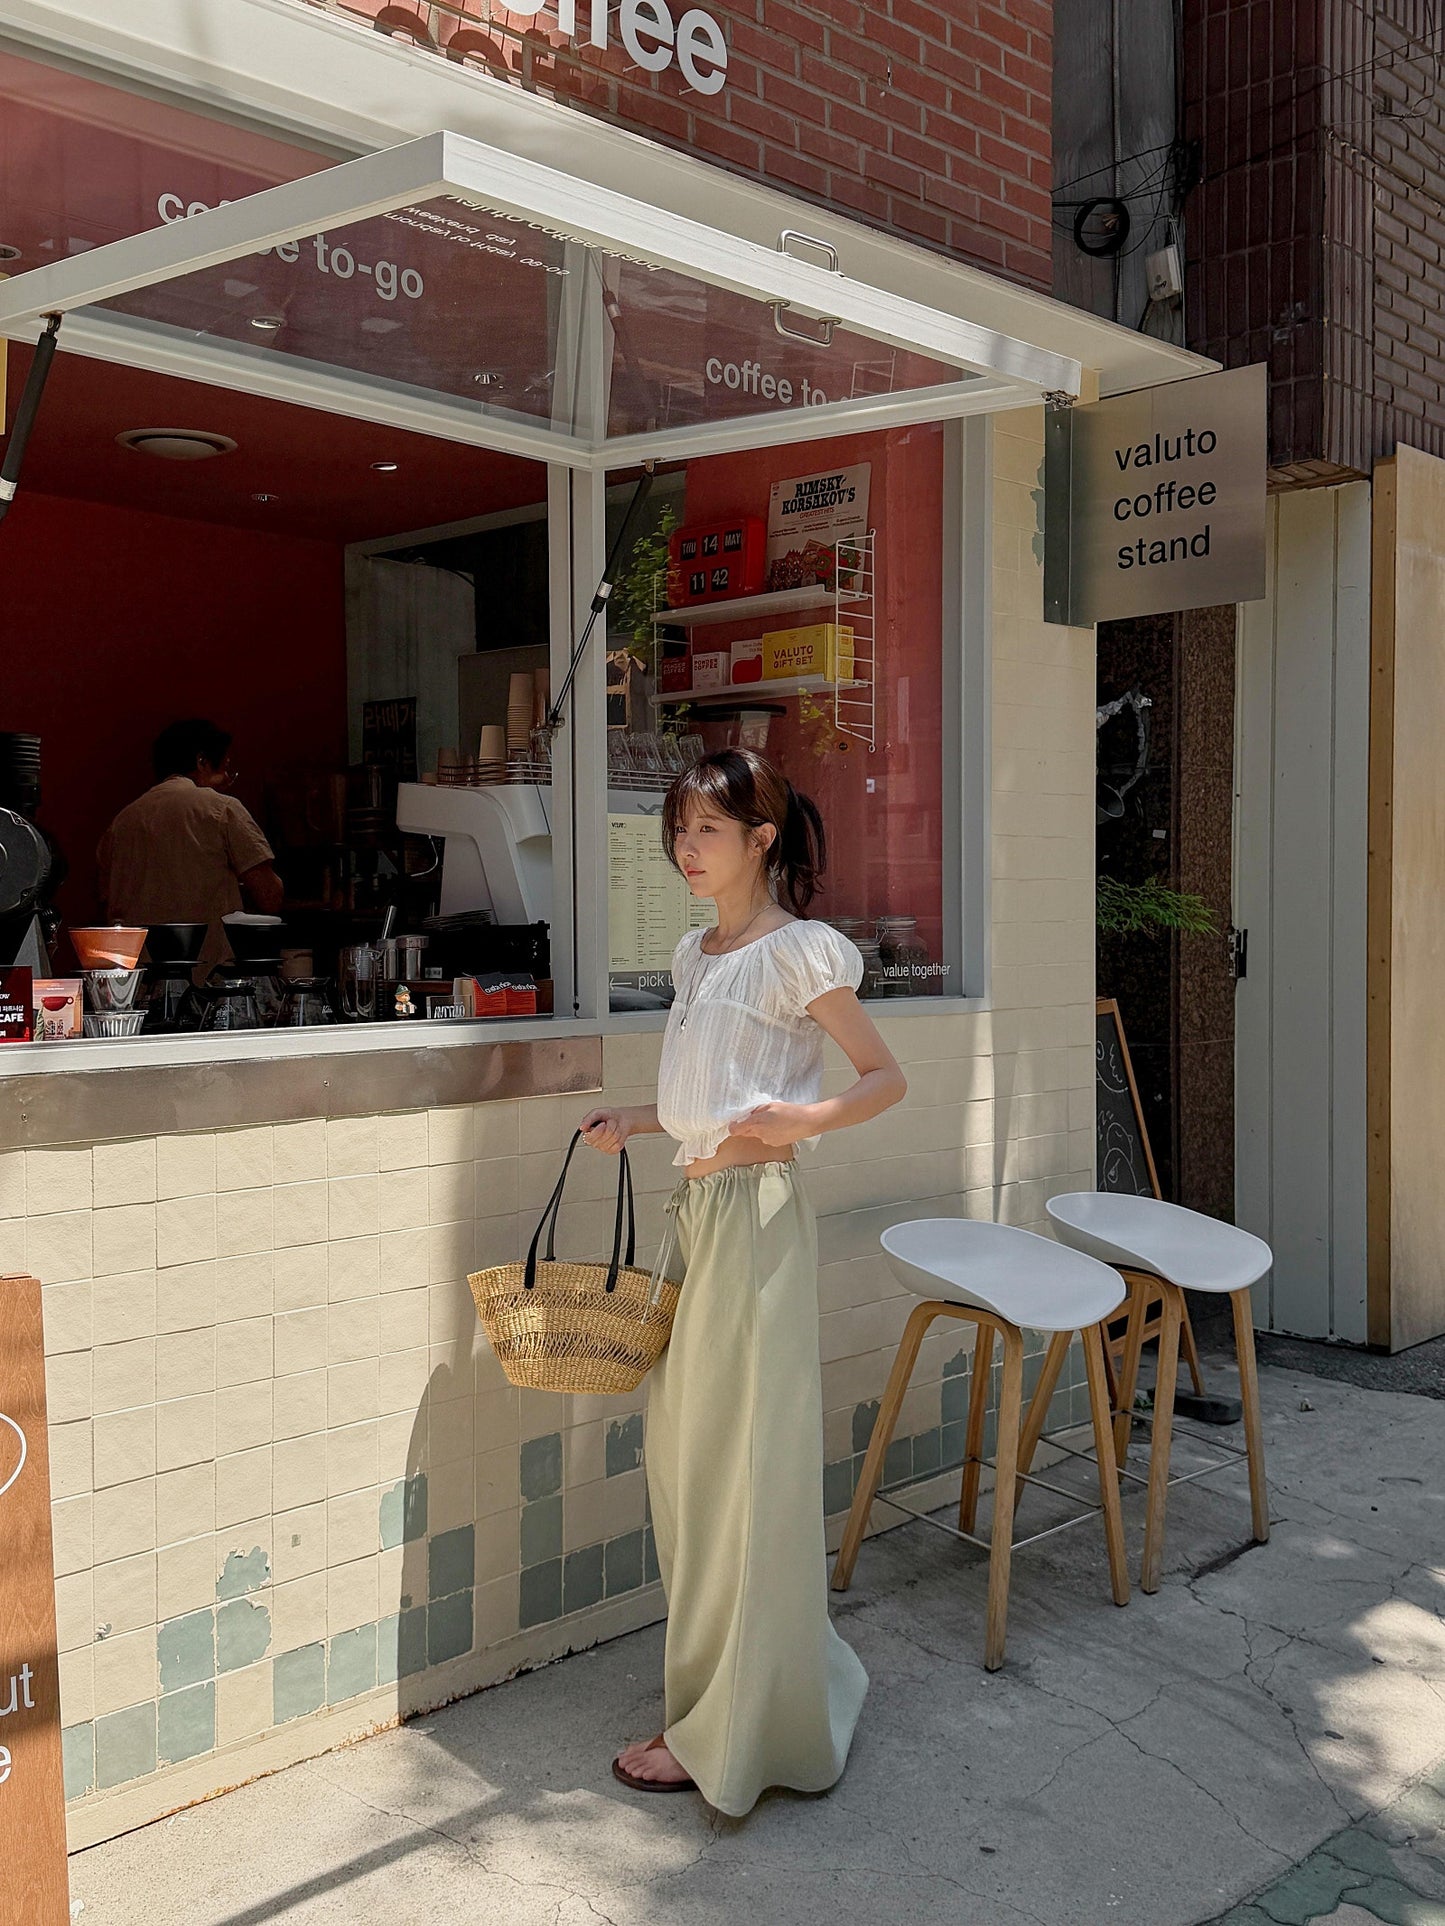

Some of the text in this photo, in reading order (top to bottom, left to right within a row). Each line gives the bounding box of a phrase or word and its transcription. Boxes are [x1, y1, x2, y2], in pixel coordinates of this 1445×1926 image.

[313, 233, 424, 301] to-go
[705, 357, 793, 404] coffee
[1115, 428, 1217, 471] valuto
[781, 487, 856, 516] KORSAKOV'S
[1114, 480, 1217, 521] coffee
[703, 535, 718, 553] 14
[724, 532, 741, 546] MAY
[1117, 524, 1210, 570] stand
[692, 568, 728, 590] 11 42
[773, 645, 814, 660] VALUTO
[773, 656, 814, 669] GIFT SET
[638, 971, 665, 992] pick
[883, 962, 951, 979] value together
